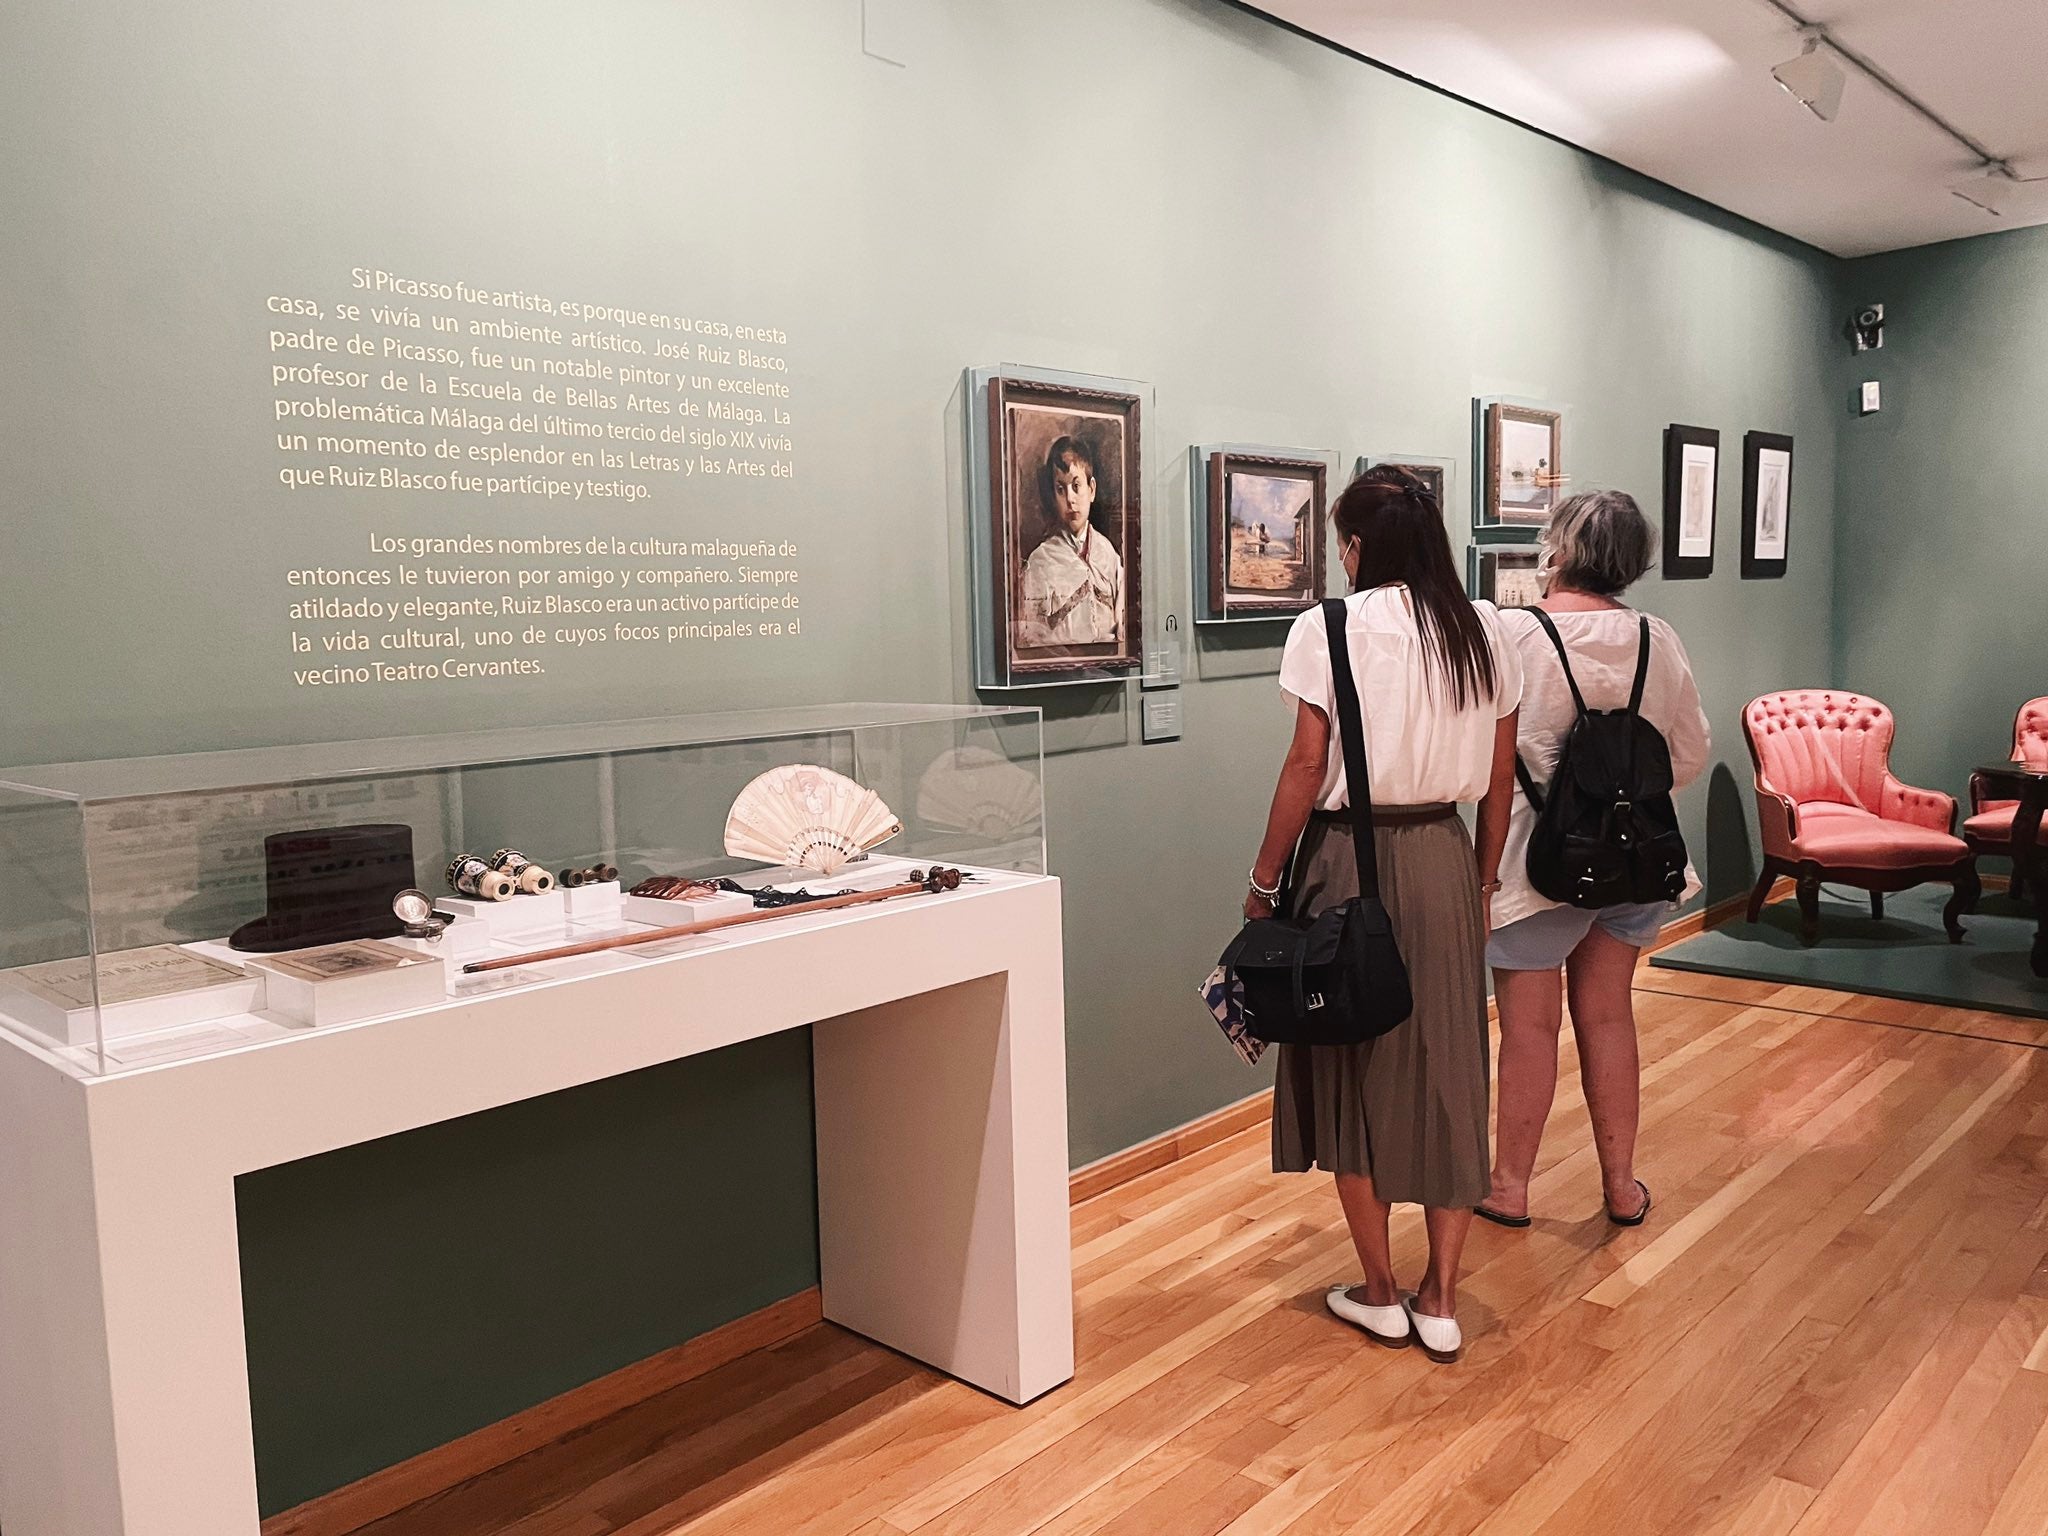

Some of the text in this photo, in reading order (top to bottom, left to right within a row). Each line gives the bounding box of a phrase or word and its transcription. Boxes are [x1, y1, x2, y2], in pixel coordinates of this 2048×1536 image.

[352, 268, 786, 344] Si Picasso fue artista, es porque en su casa, en esta
[267, 296, 788, 373] casa, se vivía un ambiente artístico. José Ruiz Blasco,
[270, 329, 789, 398] padre de Picasso, fue un notable pintor y un excelente
[273, 363, 790, 425] profesor de la Escuela de Bellas Artes de Málaga. La
[275, 397, 791, 451] problemática Málaga del último tercio del siglo XIX vivía
[278, 434, 792, 478] un momento de esplendor en las Letras y las Artes del
[280, 466, 651, 502] que Ruiz Blasco fue partícipe y testigo.
[371, 533, 796, 560] Los grandes nombres de la cultura malagueña de
[287, 565, 798, 588] entonces le tuvieron por amigo y compañero. Siempre
[290, 592, 799, 622] atildado y elegante, Ruiz Blasco era un activo partícipe de
[292, 618, 800, 652] la vida cultural, uno de cuyos focos principales era el
[294, 658, 545, 685] vecino Teatro Cervantes.
